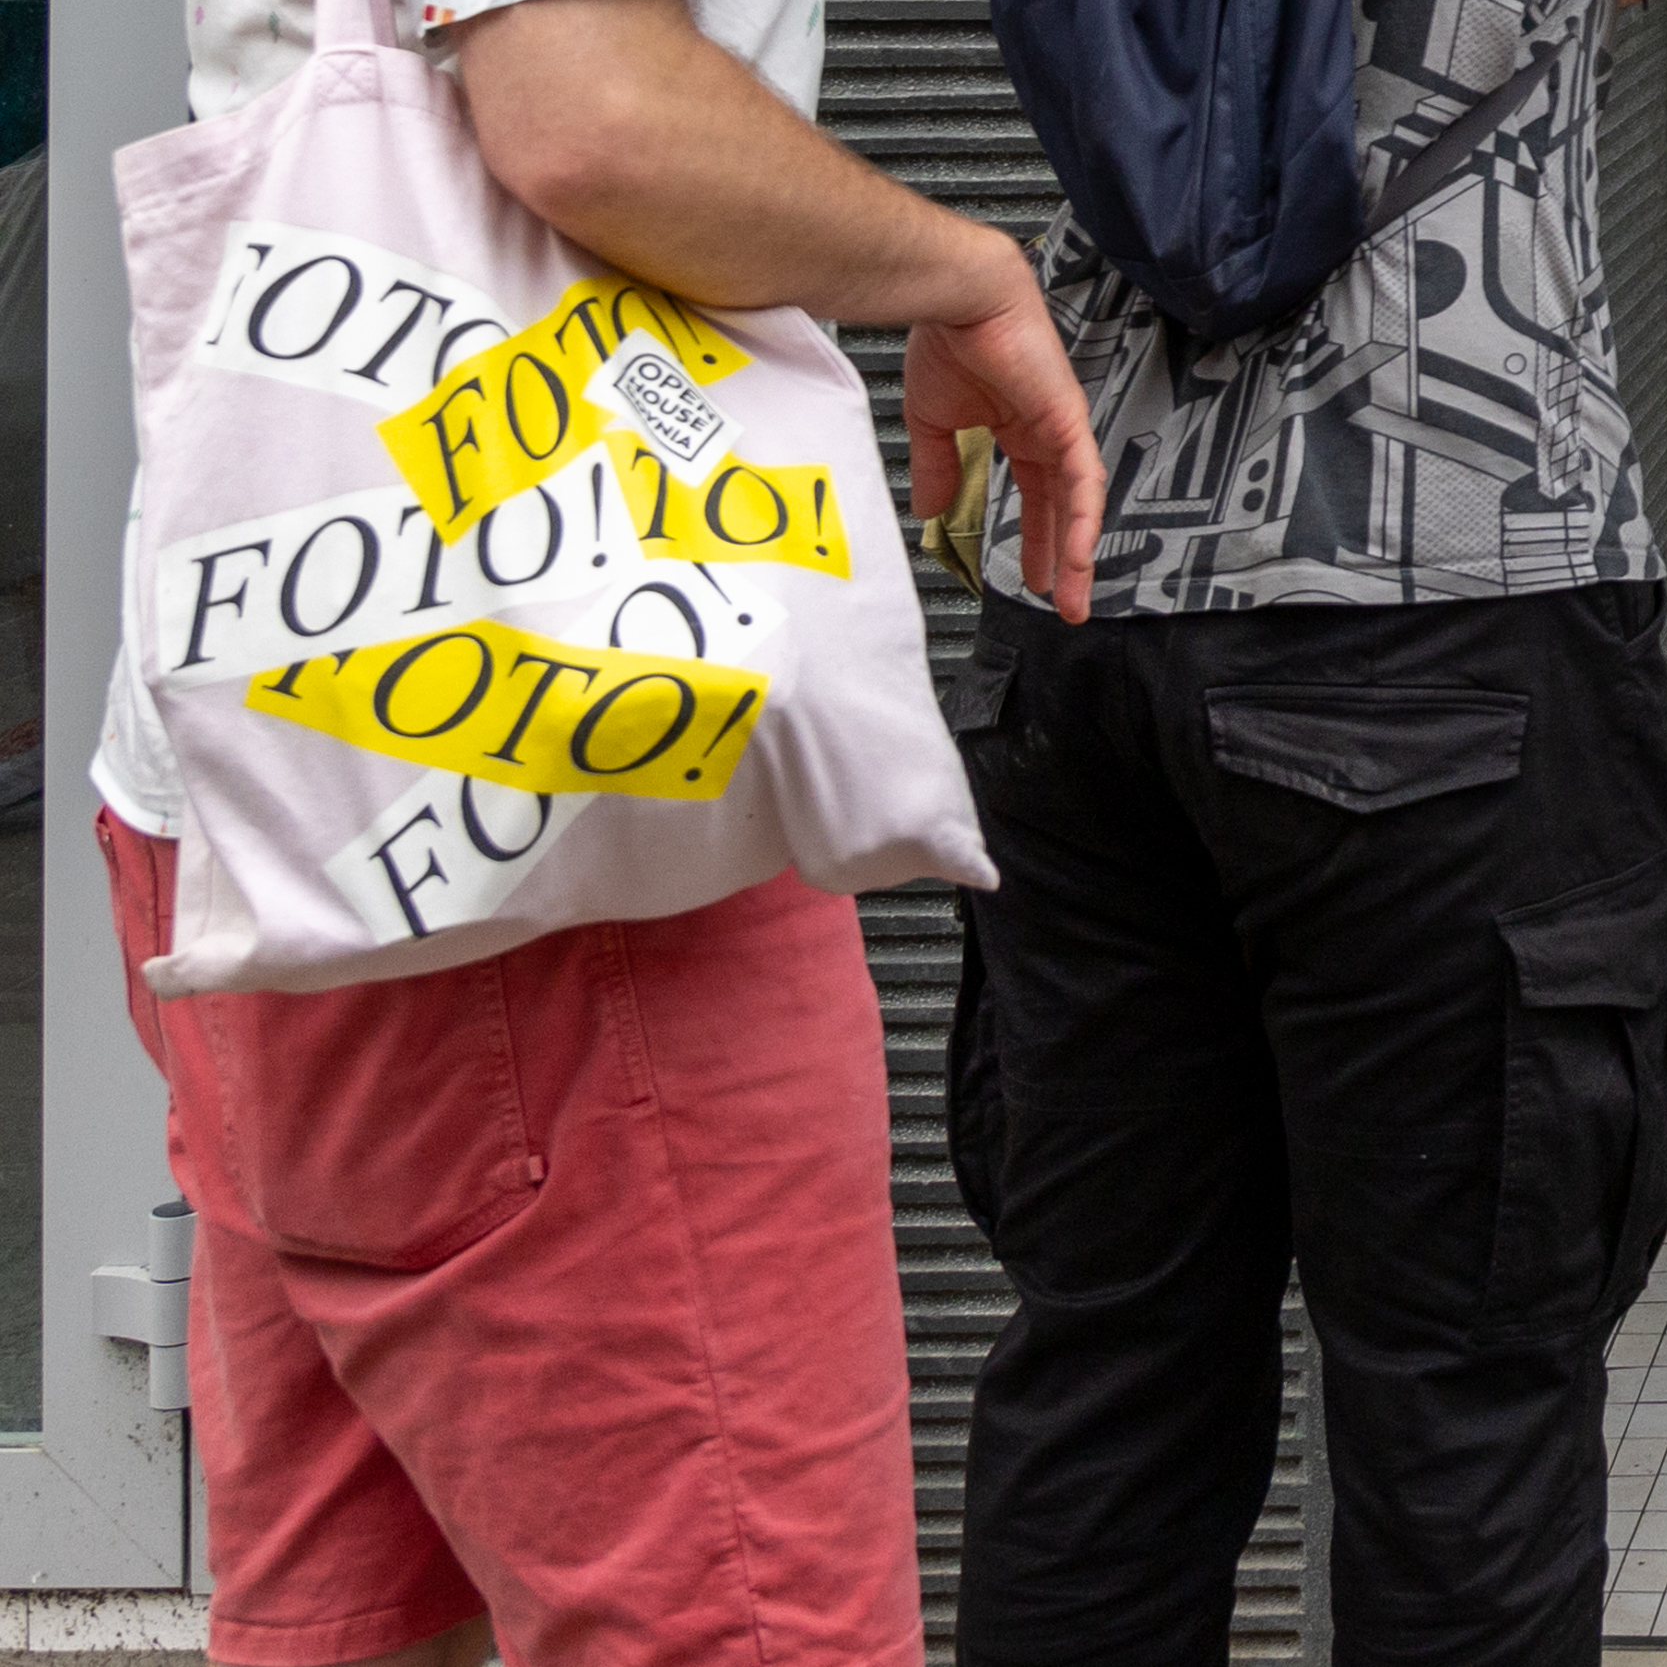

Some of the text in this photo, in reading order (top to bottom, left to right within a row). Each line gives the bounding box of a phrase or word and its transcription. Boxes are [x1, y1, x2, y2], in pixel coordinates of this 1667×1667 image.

[629, 375, 709, 432] HOUSE
[638, 361, 716, 421] OPEN
[171, 462, 608, 671] FOTO!
